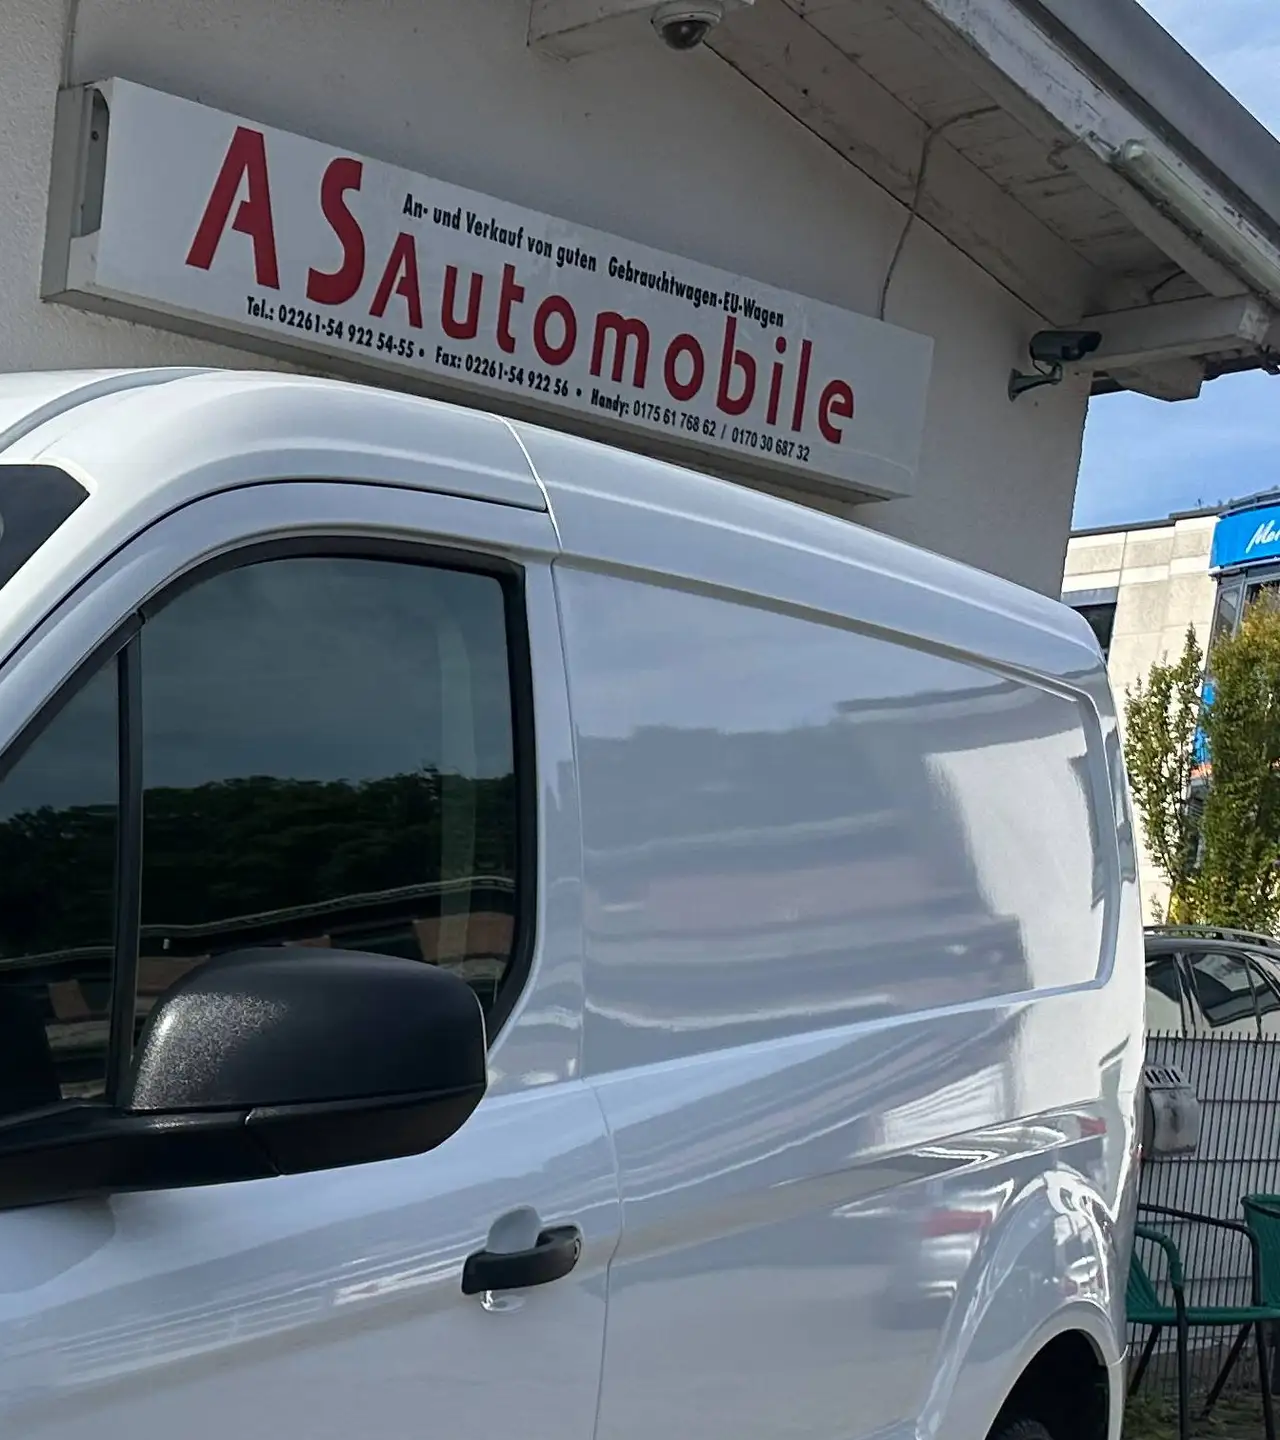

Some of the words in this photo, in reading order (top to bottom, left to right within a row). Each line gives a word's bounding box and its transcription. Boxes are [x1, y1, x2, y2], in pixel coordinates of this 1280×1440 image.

[402, 193, 428, 219] An-
[433, 207, 462, 231] und
[466, 211, 524, 249] Verkauf
[527, 235, 552, 259] von
[556, 245, 597, 272] guten
[247, 296, 274, 321] Tel.:
[278, 304, 343, 339] 02261-54
[348, 324, 373, 347] 922
[376, 332, 414, 358] 54-55
[435, 346, 461, 369] Fax:
[465, 354, 524, 385] 02261-54
[528, 370, 550, 392] 922
[554, 380, 569, 397] 56
[591, 388, 630, 417] Handy:
[633, 402, 661, 423] 0175
[663, 408, 676, 426] 61
[680, 412, 700, 433] 768
[702, 418, 716, 438] 62
[732, 427, 757, 447] 0170
[760, 434, 773, 452] 30
[796, 444, 810, 462] 32
